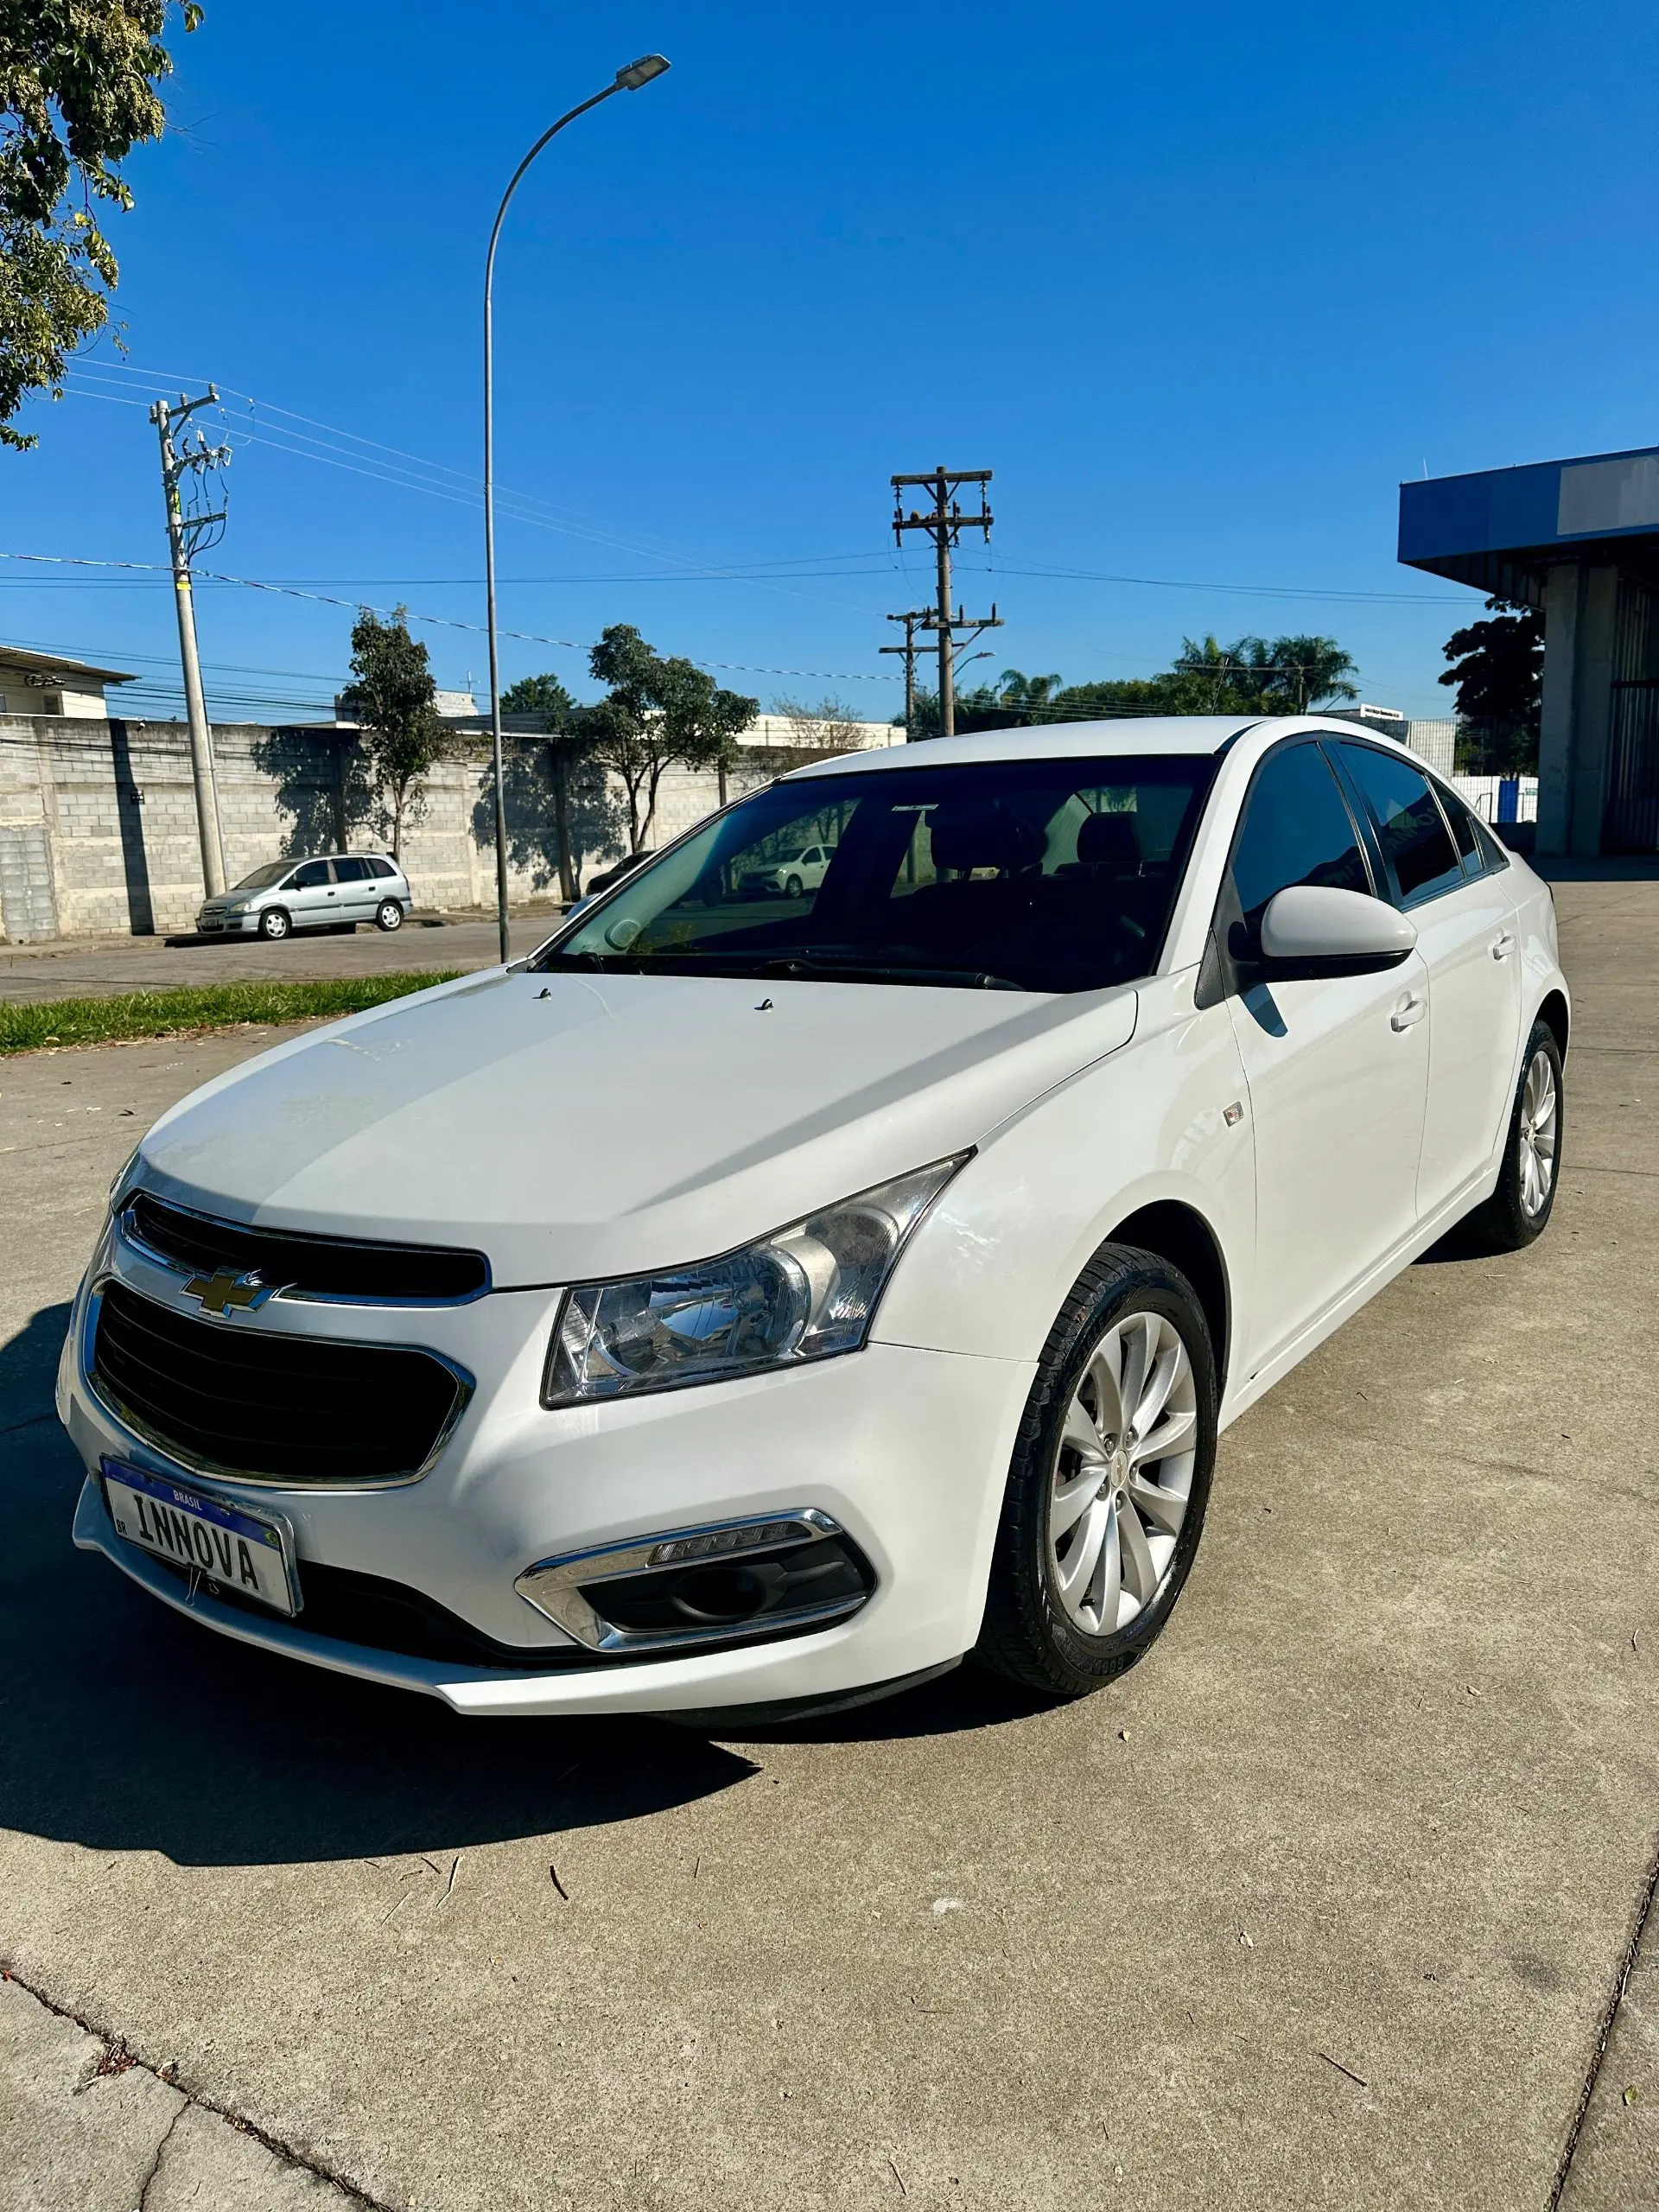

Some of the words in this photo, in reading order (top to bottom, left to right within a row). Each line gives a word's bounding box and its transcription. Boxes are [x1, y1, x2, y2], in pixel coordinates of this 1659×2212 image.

[173, 1490, 202, 1511] BRASIL
[116, 1519, 128, 1536] BR
[133, 1494, 259, 1590] INNOVA
